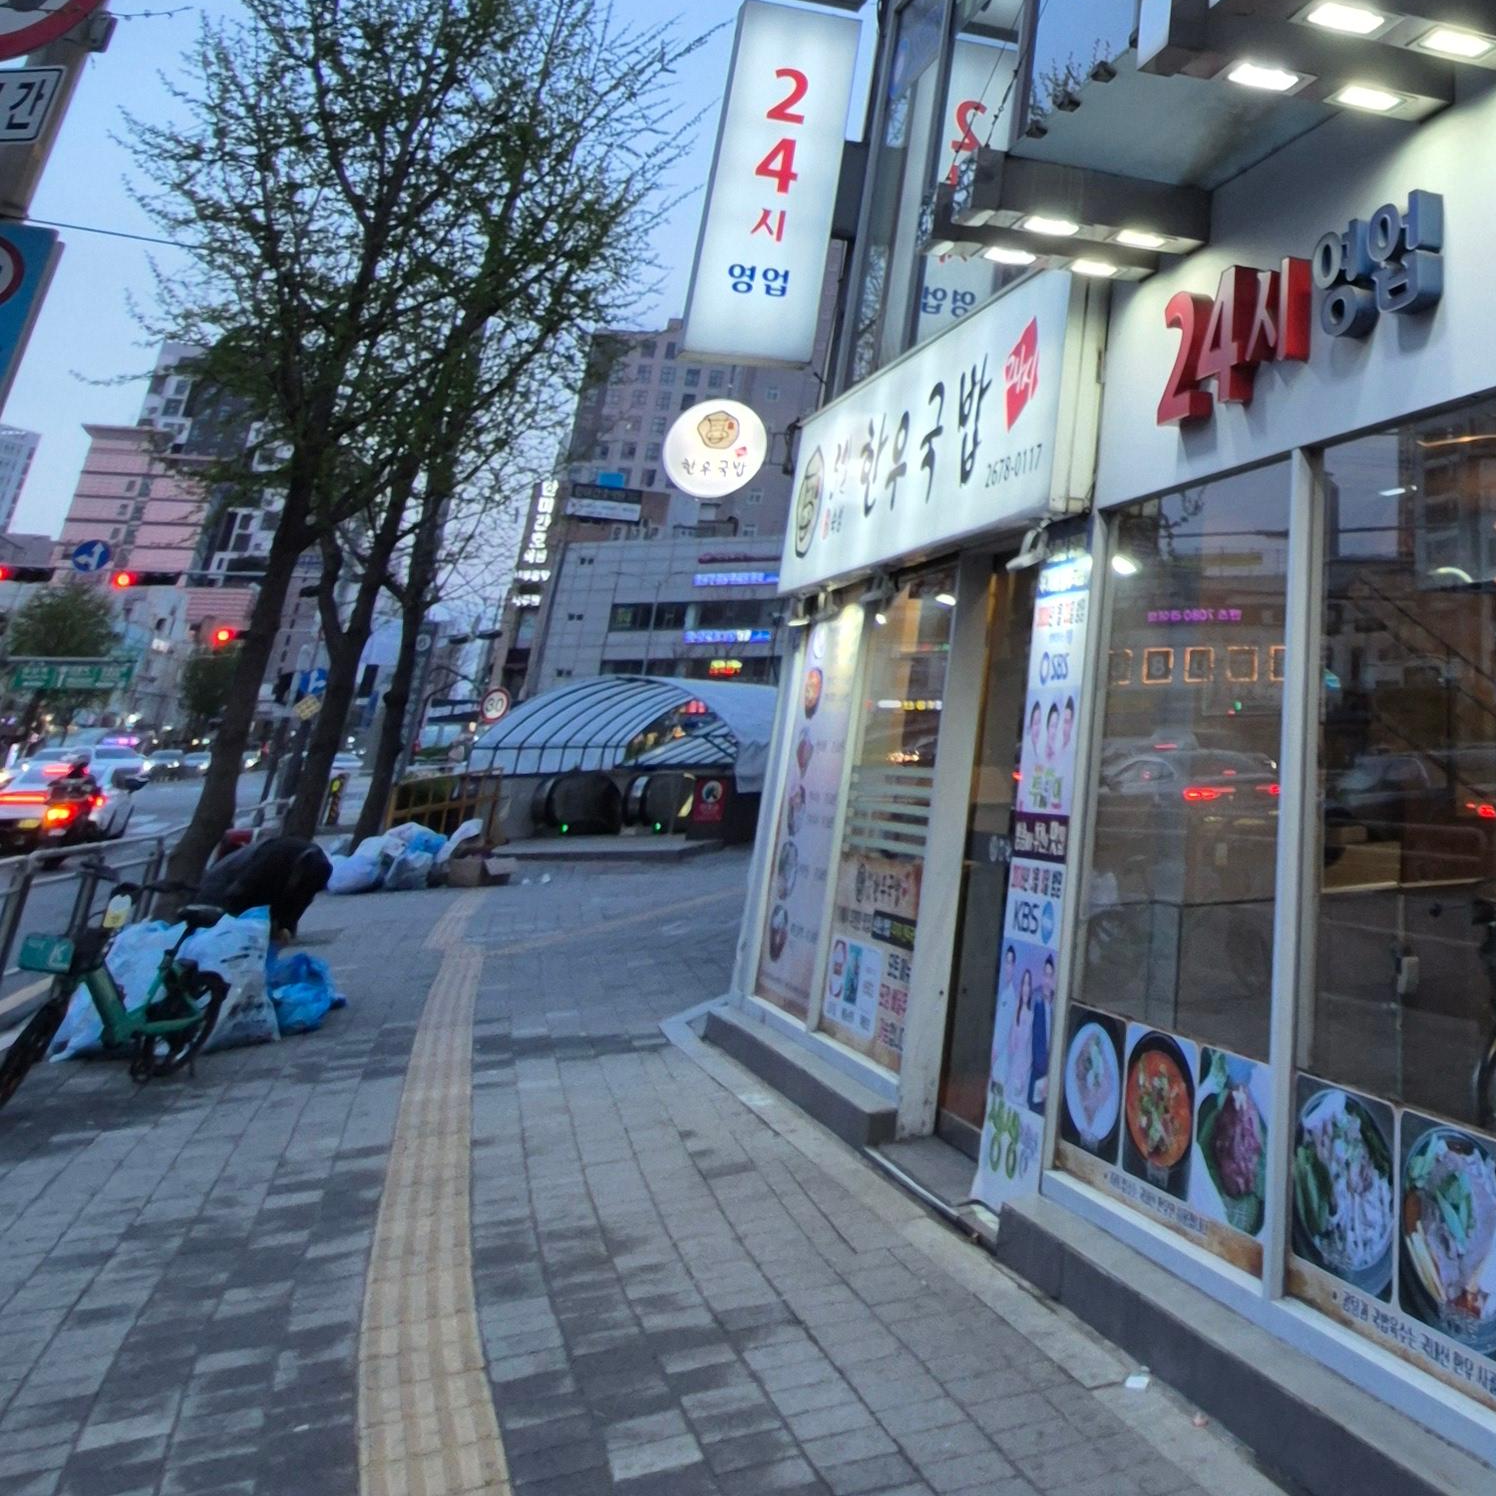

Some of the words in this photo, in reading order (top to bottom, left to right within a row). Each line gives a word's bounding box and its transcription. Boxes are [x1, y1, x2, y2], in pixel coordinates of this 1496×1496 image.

[0, 78, 47, 130] 간
[750, 68, 809, 243] 24시
[728, 262, 790, 298] 영업
[1157, 255, 1312, 426] 24시
[1312, 189, 1443, 338] 영업
[860, 352, 993, 518] 한우국밥
[681, 458, 746, 478] 한우국밥
[1013, 900, 1040, 935] KBS
